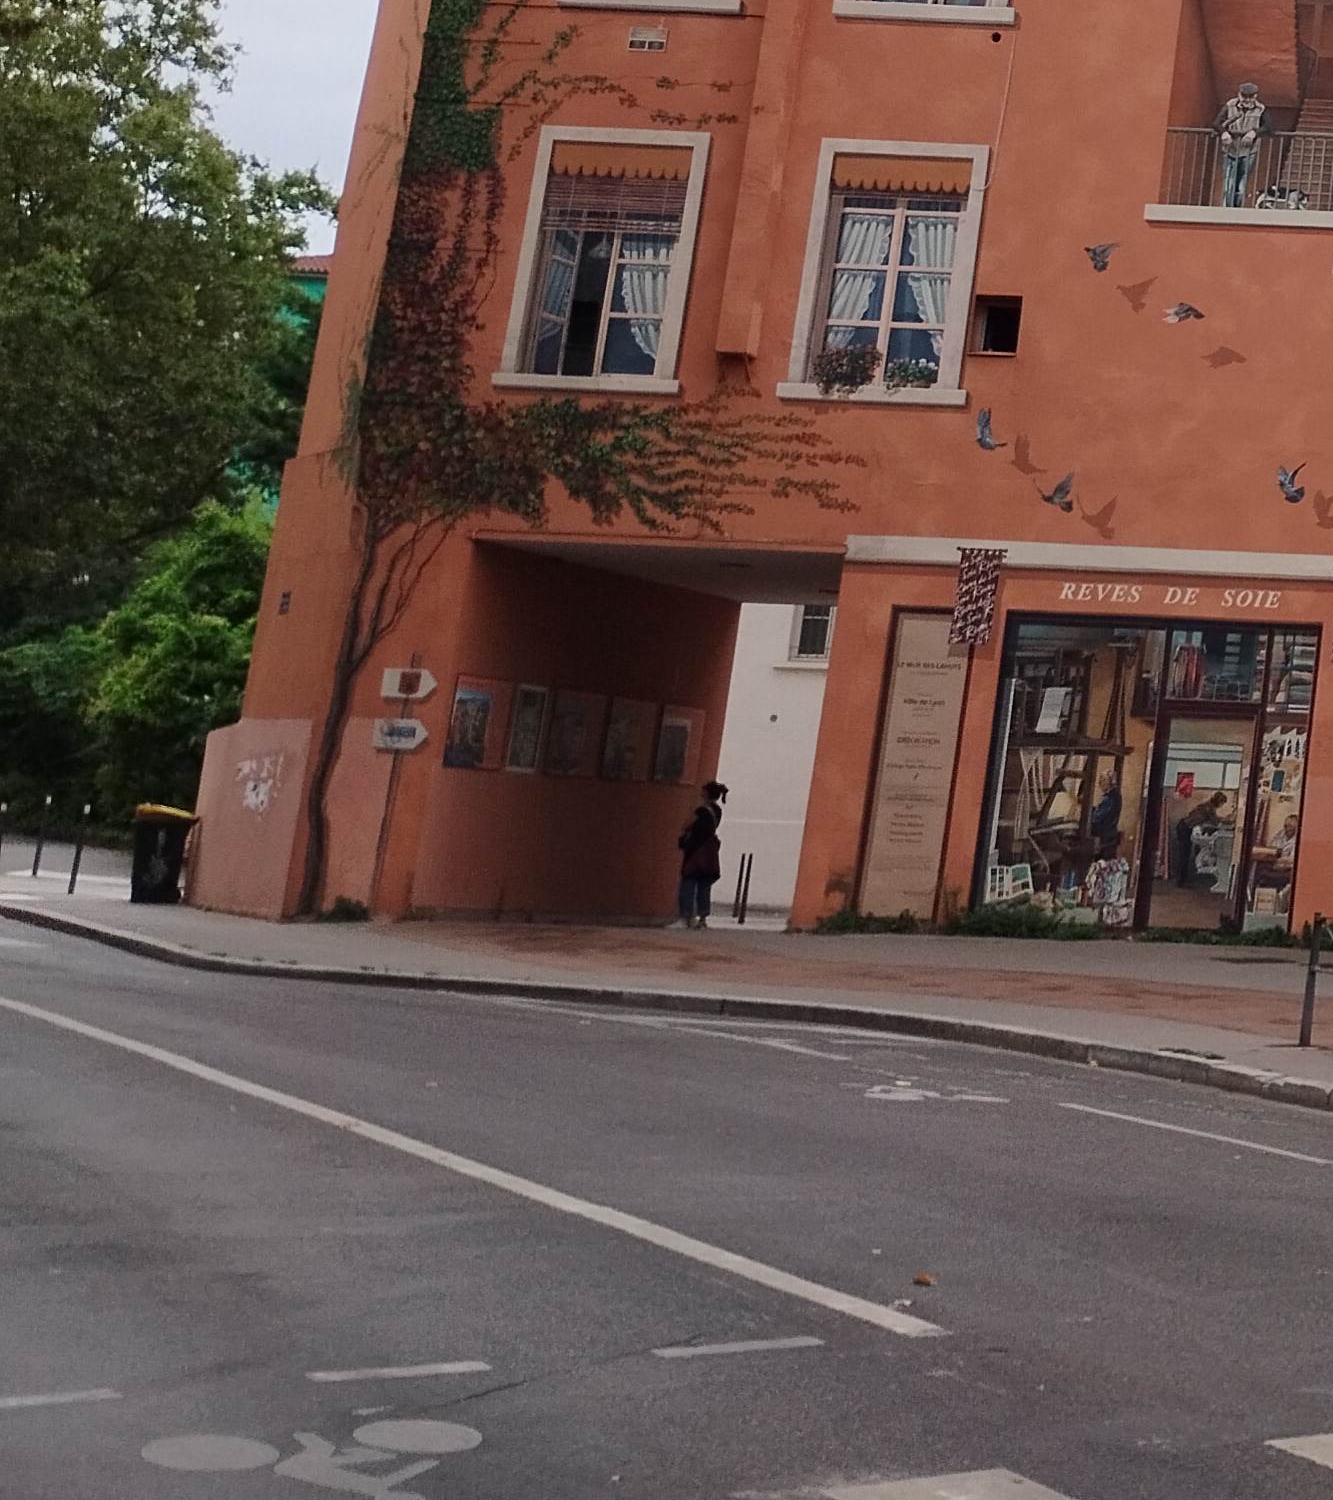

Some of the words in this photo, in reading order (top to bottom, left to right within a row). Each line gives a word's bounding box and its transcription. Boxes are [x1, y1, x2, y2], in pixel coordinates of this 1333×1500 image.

[1059, 582, 1143, 603] REVES
[1164, 586, 1200, 606] DE
[1221, 588, 1282, 609] SOIE
